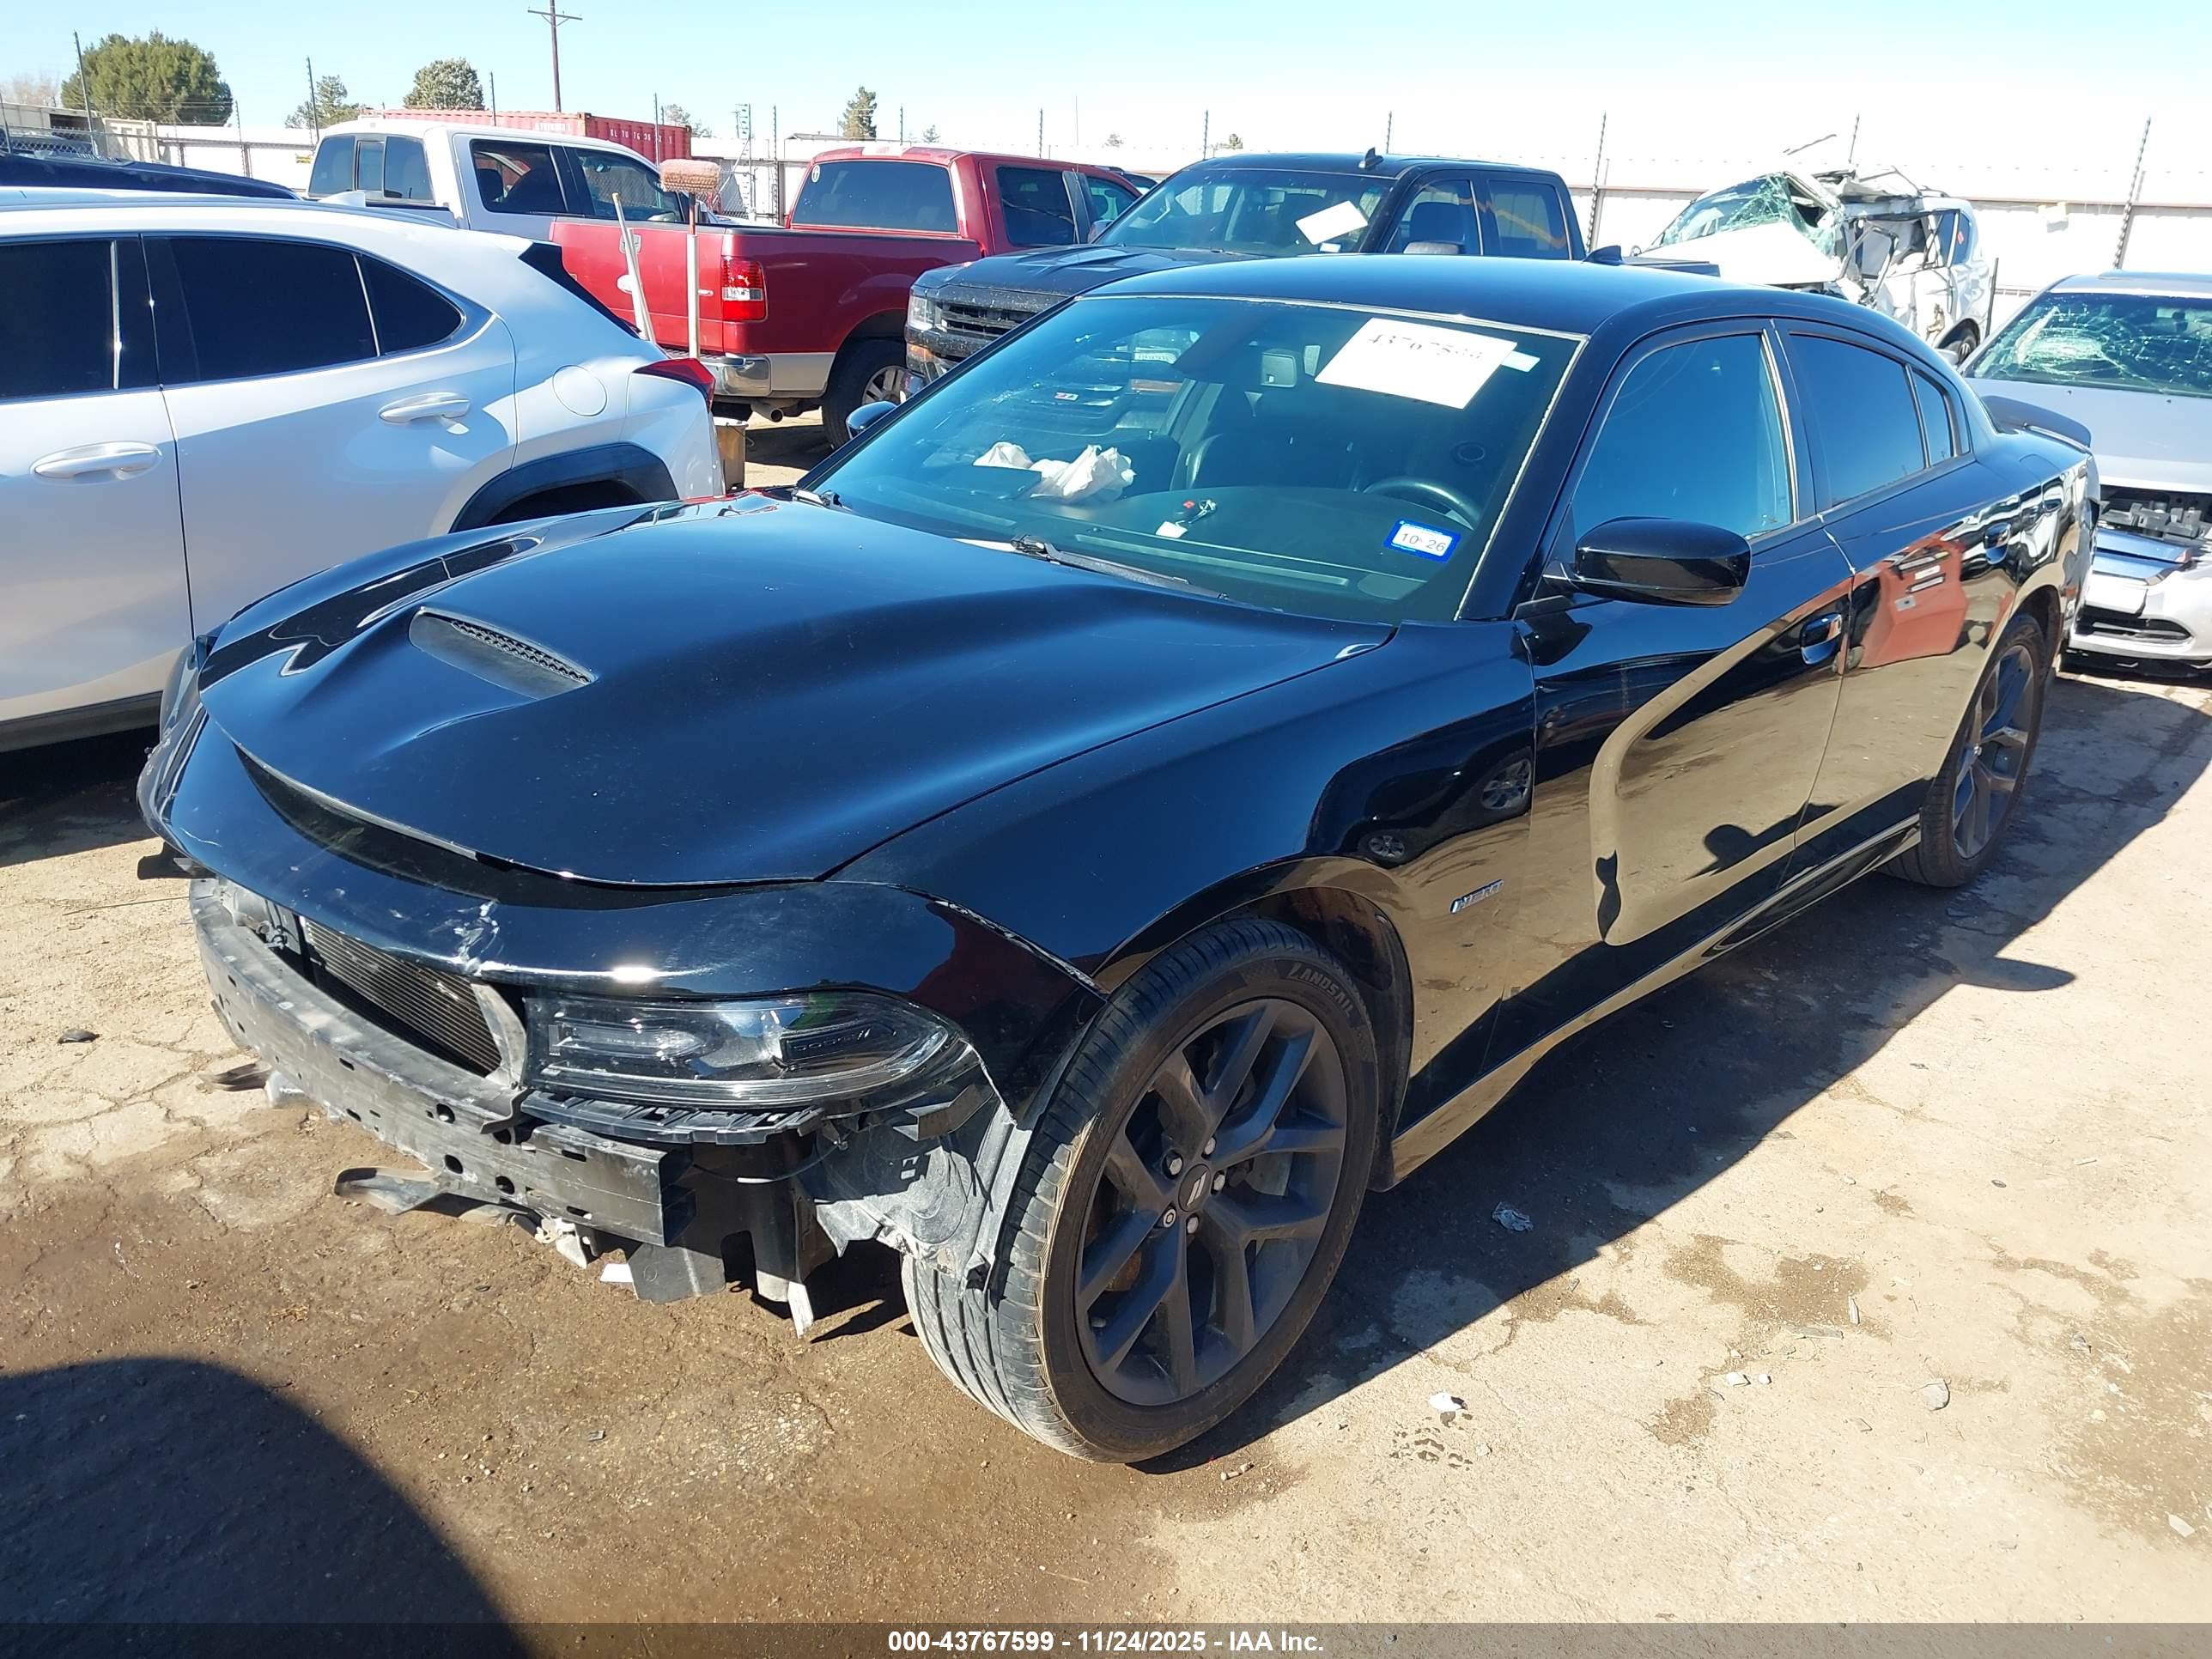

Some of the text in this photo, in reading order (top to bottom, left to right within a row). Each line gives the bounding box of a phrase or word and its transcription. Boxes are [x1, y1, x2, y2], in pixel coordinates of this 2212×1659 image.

[1401, 532, 1447, 552] 10 26
[1285, 962, 1355, 1018] LANDSAIL
